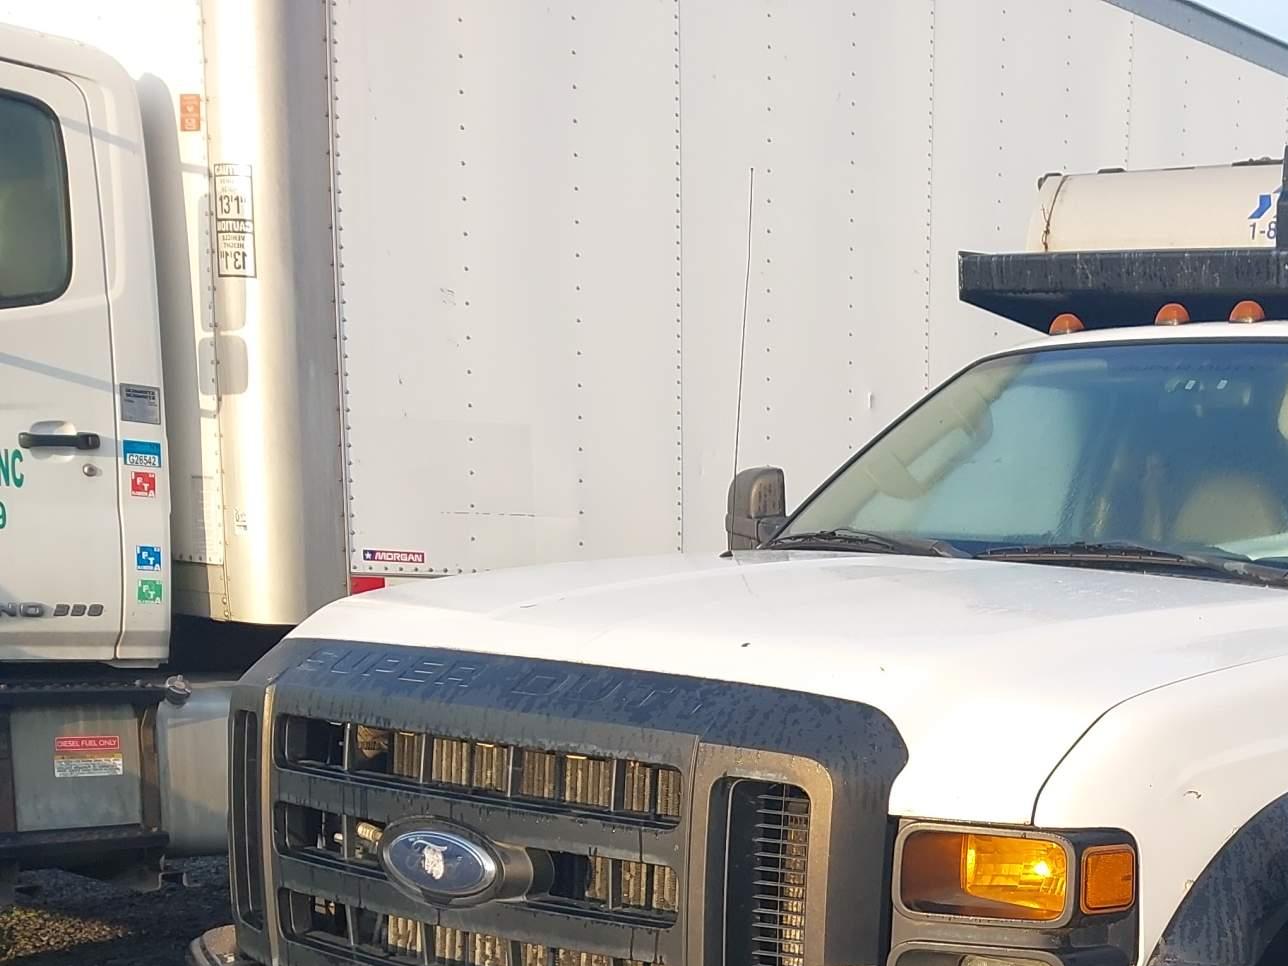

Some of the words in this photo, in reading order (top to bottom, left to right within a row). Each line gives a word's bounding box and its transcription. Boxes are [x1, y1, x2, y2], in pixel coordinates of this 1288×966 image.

[374, 552, 422, 562] MORGAN
[299, 648, 488, 688] SUPER
[98, 738, 117, 746] ONLY
